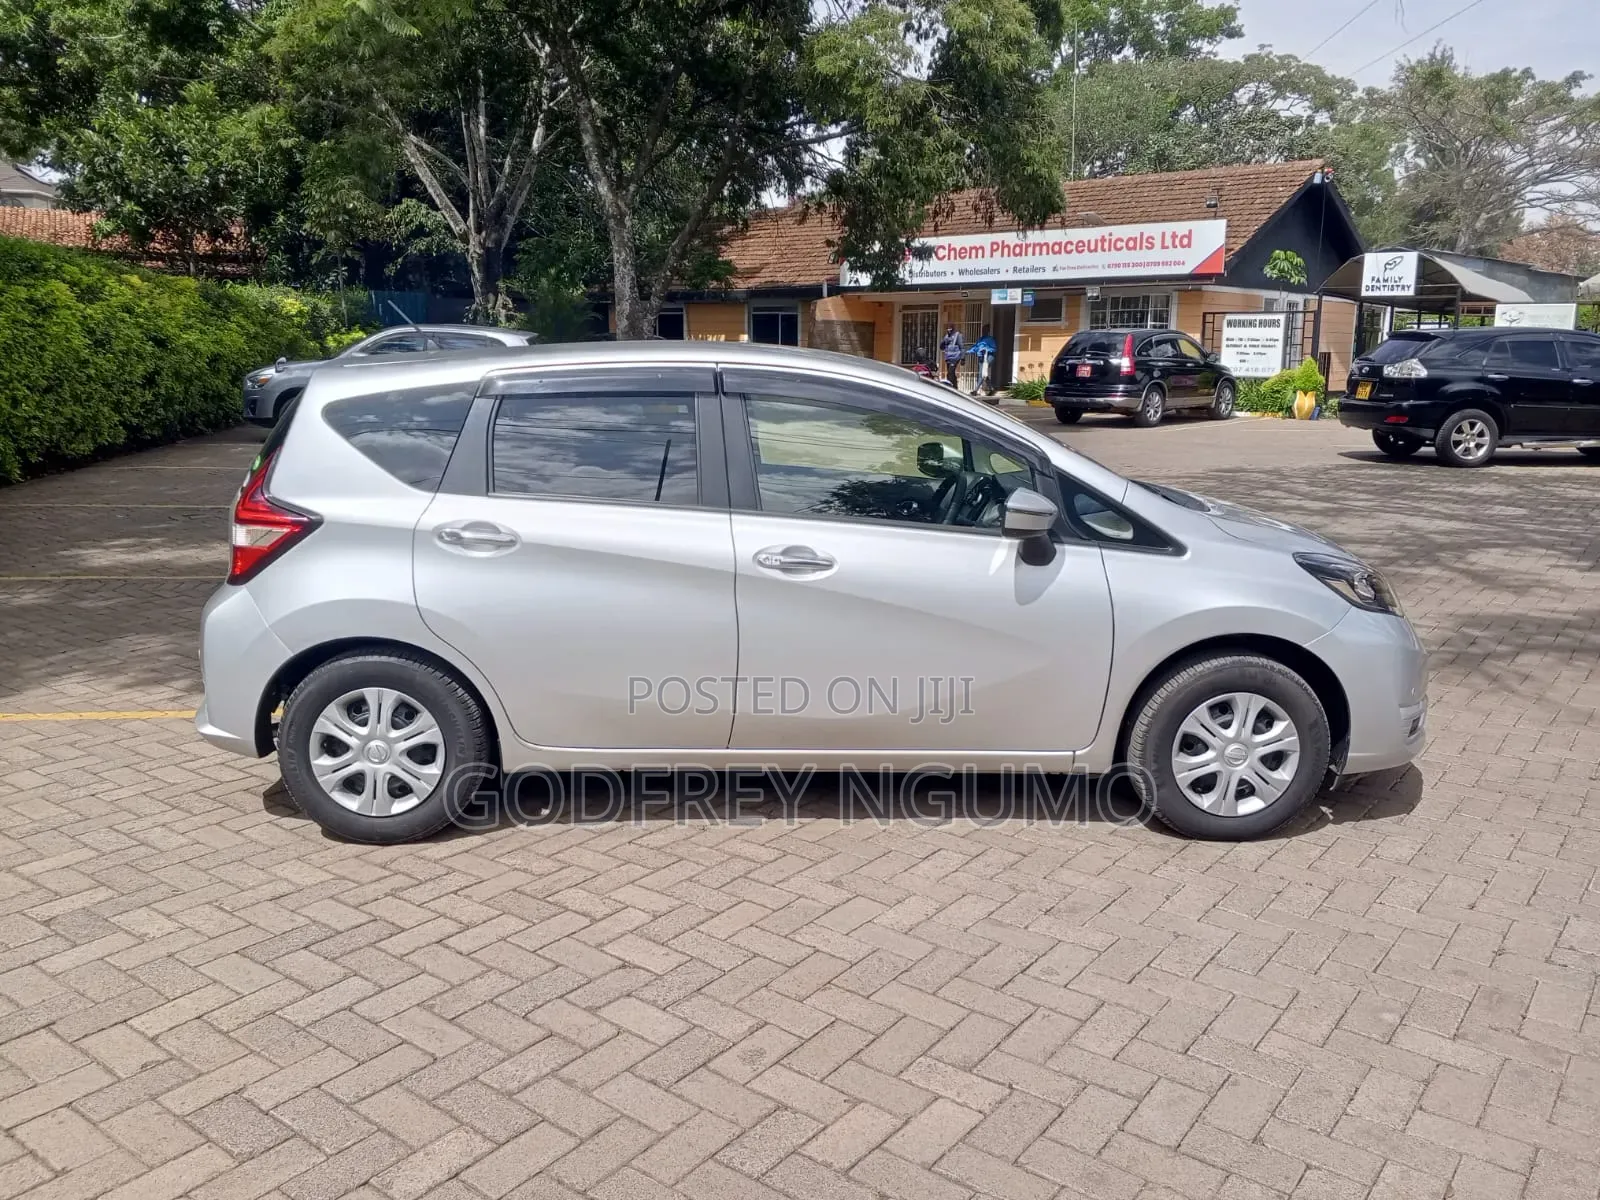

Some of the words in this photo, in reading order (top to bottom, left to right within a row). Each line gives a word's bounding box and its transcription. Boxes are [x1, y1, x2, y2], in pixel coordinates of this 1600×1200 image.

[990, 231, 1156, 259] Pharmaceuticals
[1160, 229, 1193, 250] Ltd
[958, 266, 1001, 277] Wholesalers
[1012, 264, 1046, 275] Retailers
[1370, 275, 1404, 284] FAMILY
[1365, 284, 1412, 292] DENTISTRY
[1226, 318, 1258, 329] WORKING
[1258, 318, 1281, 329] HOURS
